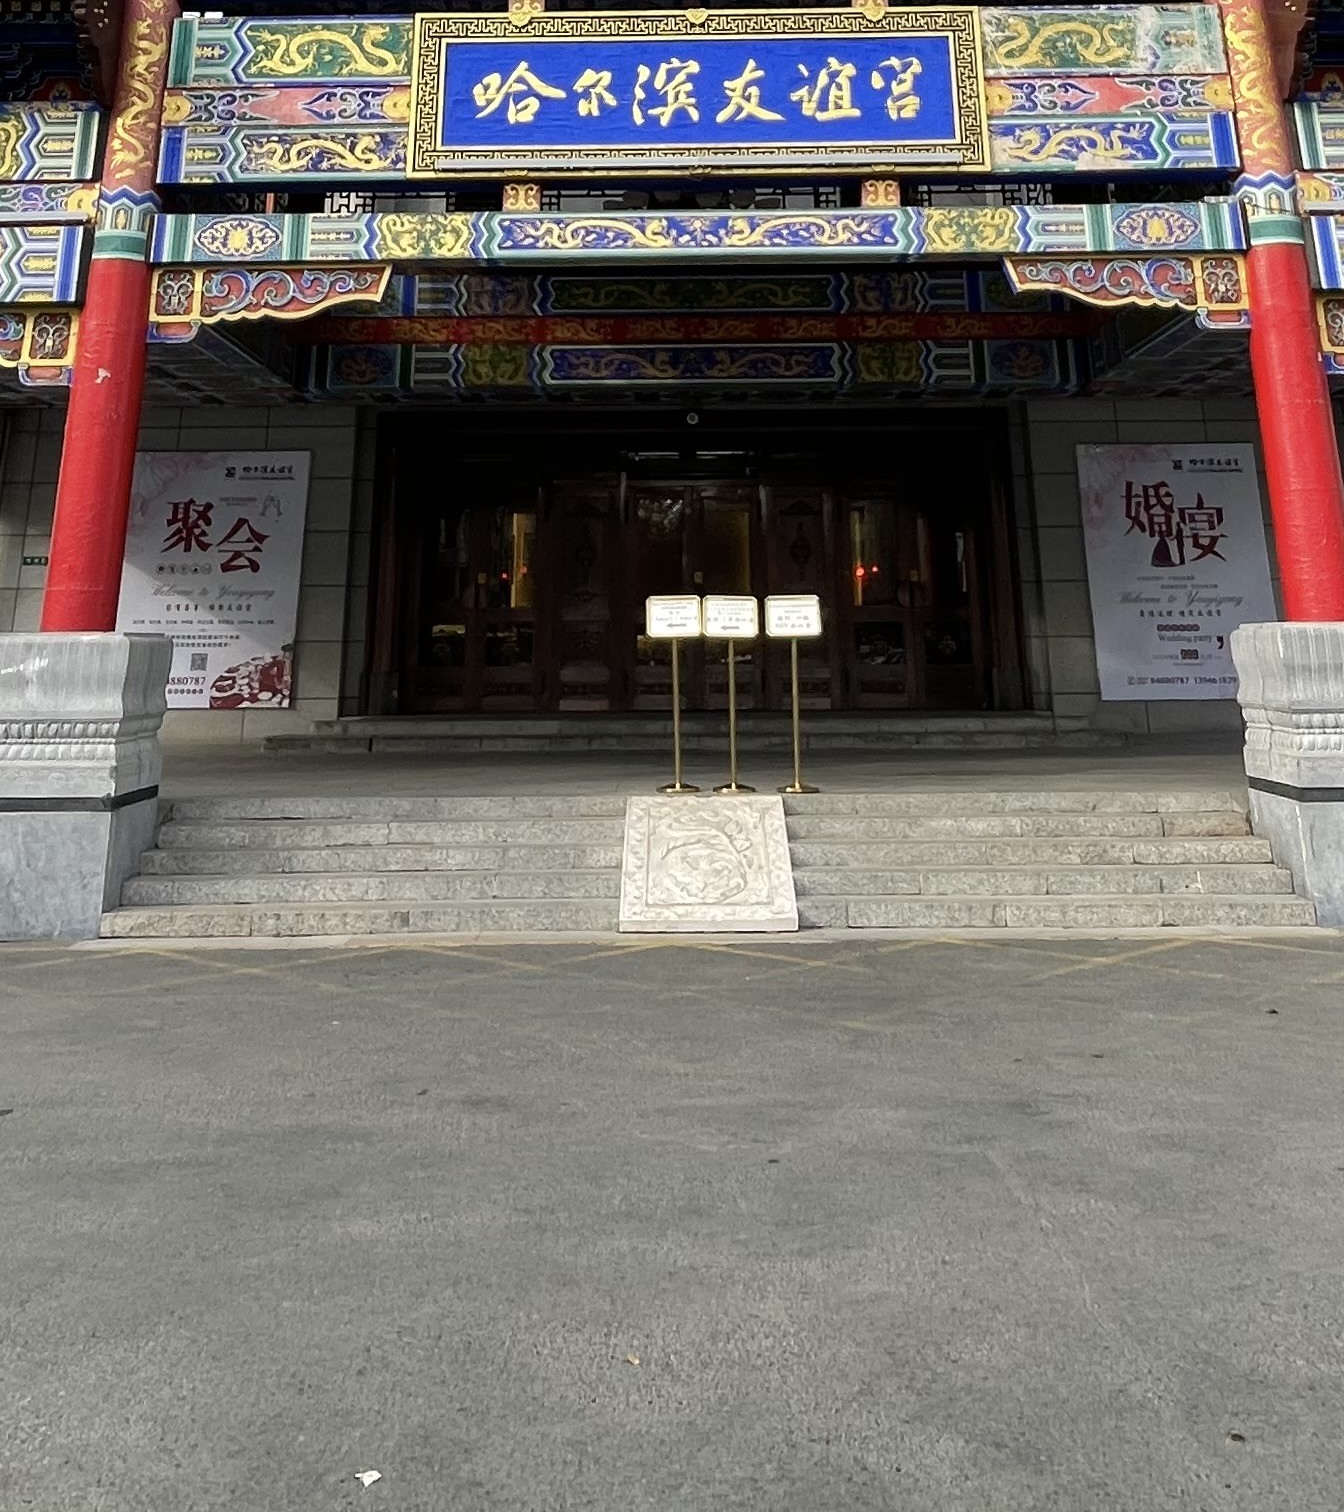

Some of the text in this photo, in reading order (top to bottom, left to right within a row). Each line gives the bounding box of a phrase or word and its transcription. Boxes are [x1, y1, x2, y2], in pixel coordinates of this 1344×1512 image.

[472, 57, 923, 126] 哈尔滨友谊宫
[160, 498, 270, 573] 聚会
[1120, 480, 1228, 566] 婚宴
